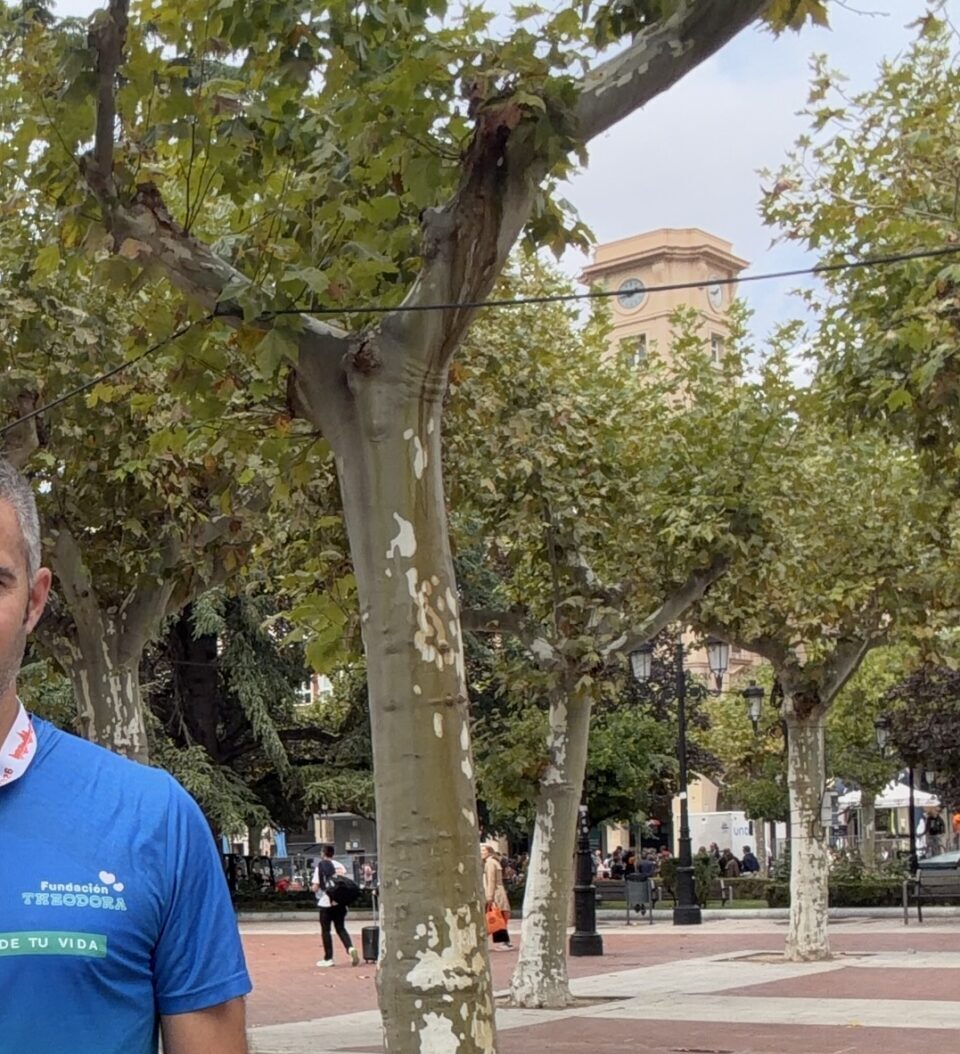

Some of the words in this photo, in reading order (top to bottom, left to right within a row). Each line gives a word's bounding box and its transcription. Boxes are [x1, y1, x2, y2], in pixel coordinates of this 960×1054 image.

[40, 880, 109, 894] Fundación
[21, 891, 127, 911] THEODORA
[28, 937, 49, 949] TU
[58, 937, 99, 951] VIDA
